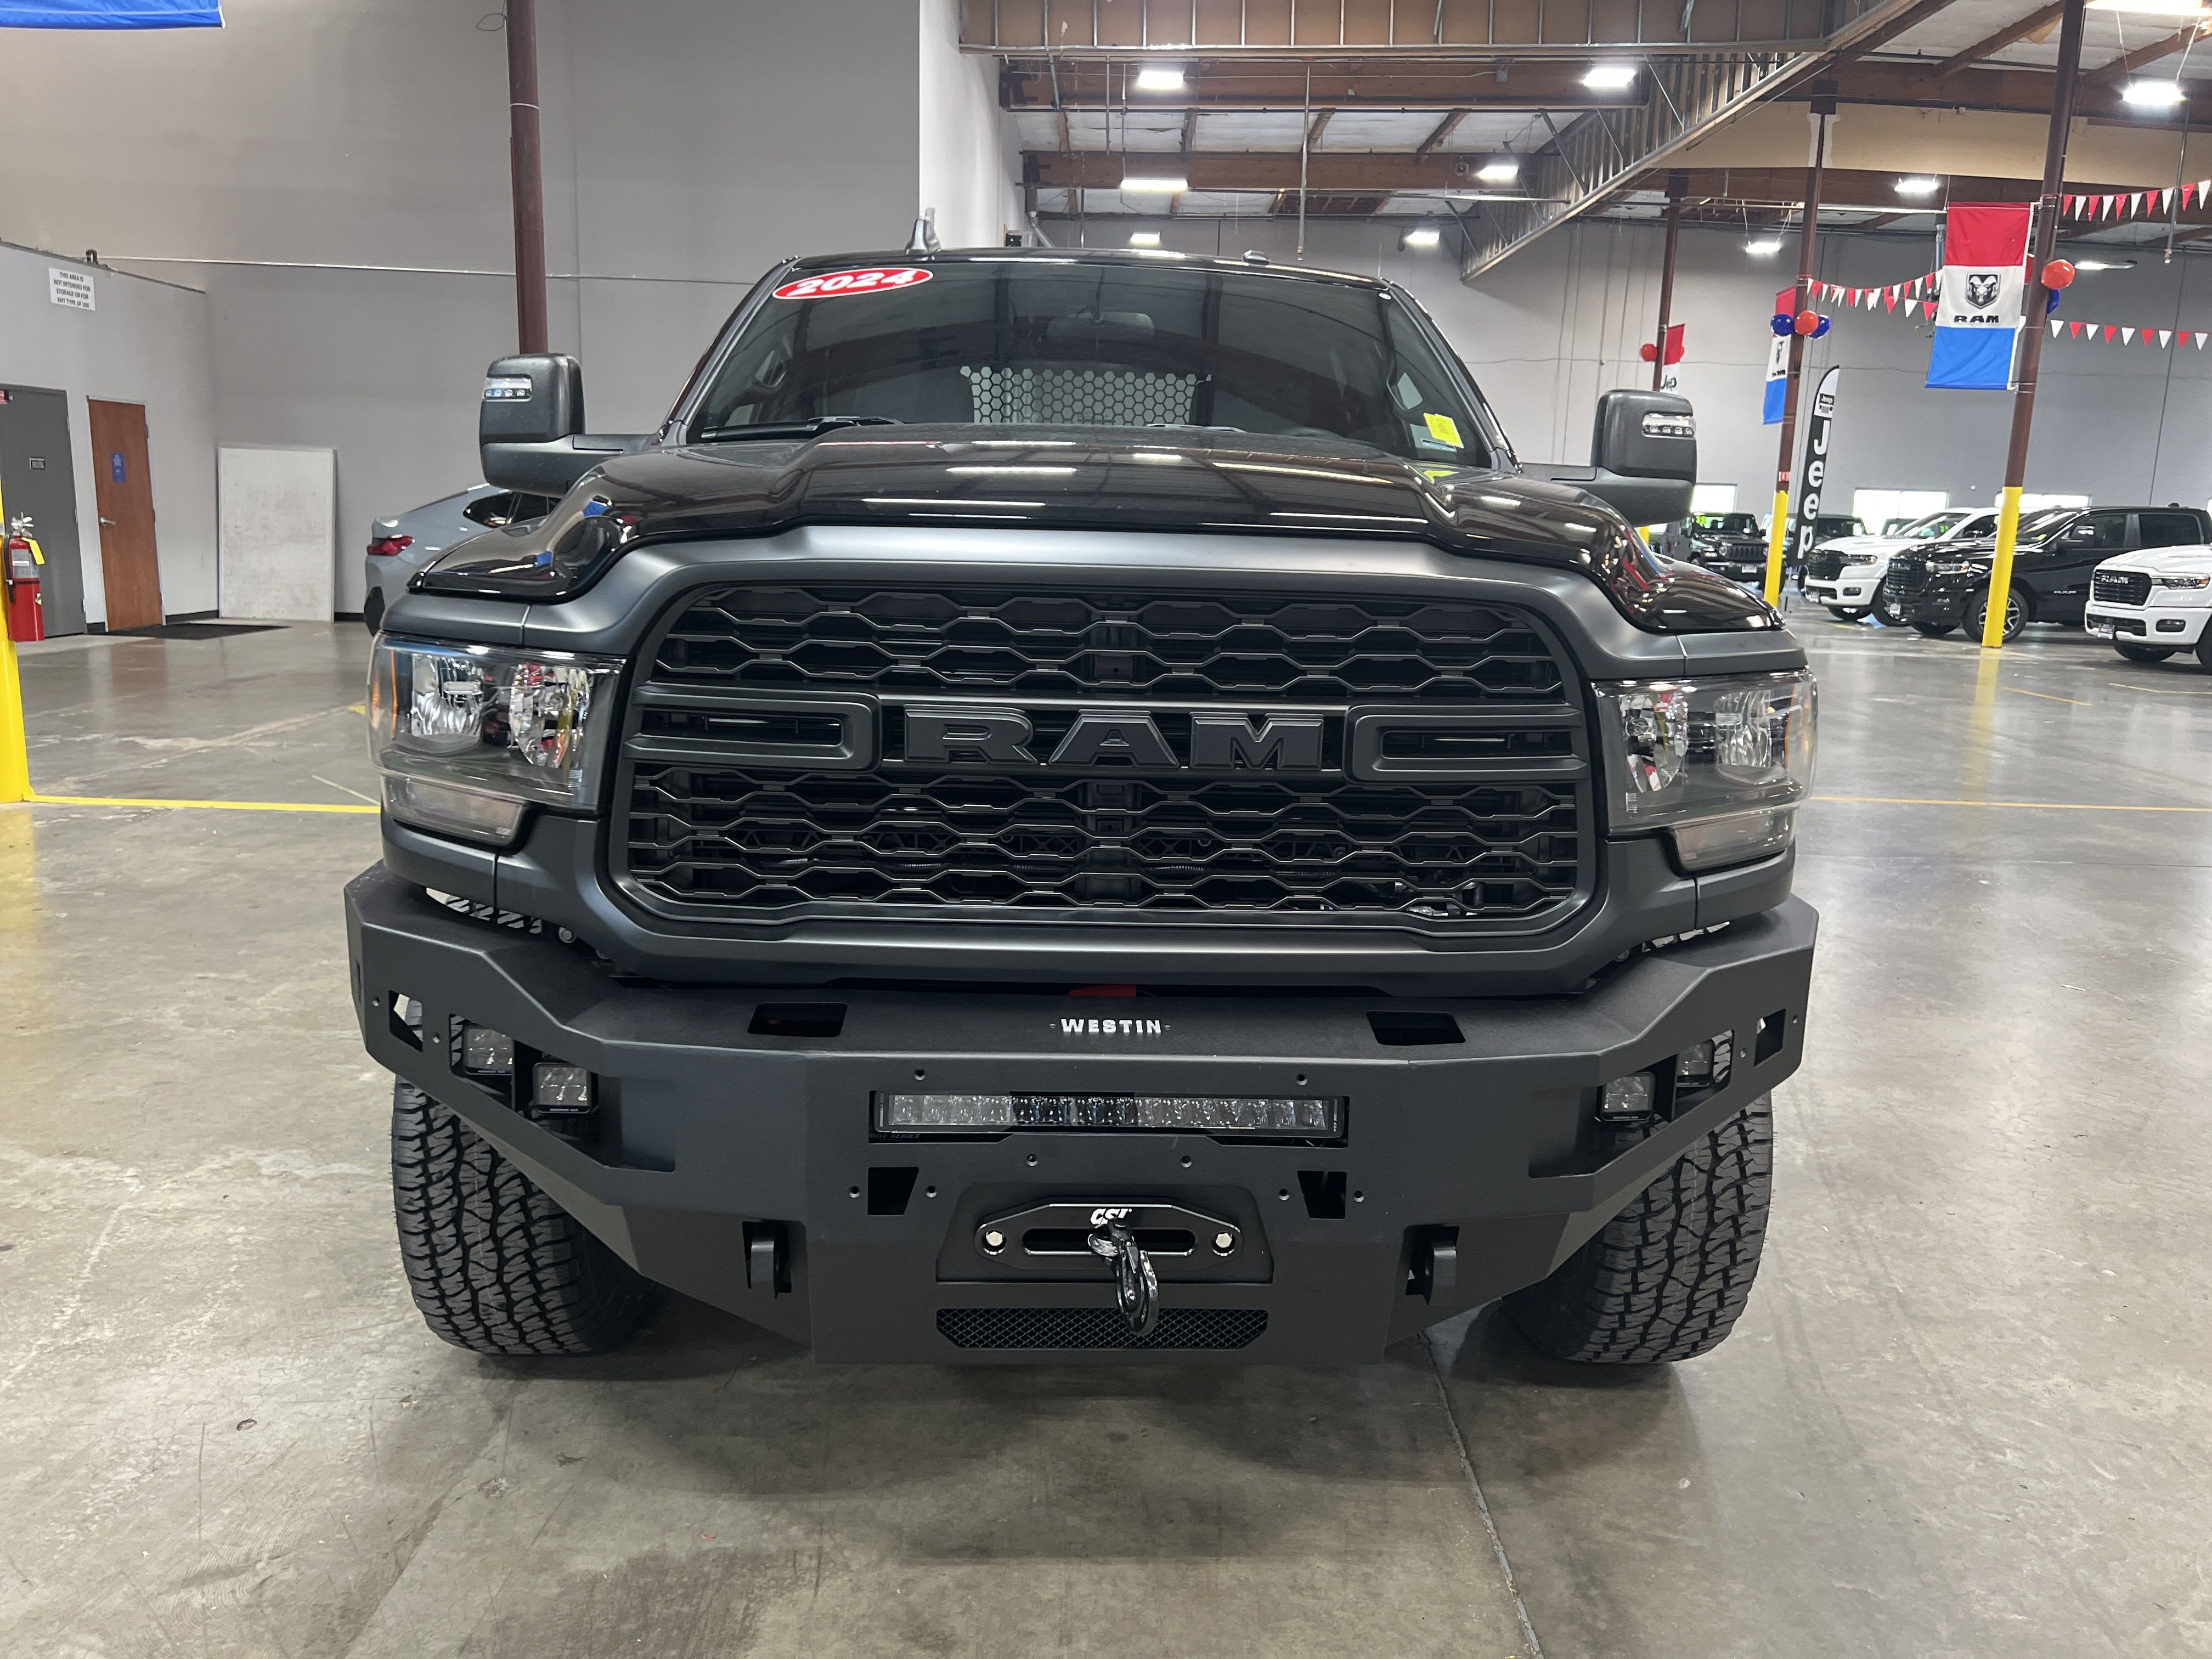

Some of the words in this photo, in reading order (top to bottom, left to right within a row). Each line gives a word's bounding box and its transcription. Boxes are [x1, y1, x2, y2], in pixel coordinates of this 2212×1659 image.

[63, 281, 82, 290] INTENDED
[786, 270, 917, 297] 2024
[56, 288, 74, 297] STORAGE
[1797, 420, 1831, 560] Jeep
[2101, 575, 2129, 584] RAM
[904, 704, 1324, 771] RAM
[1060, 1019, 1161, 1034] WESTIN
